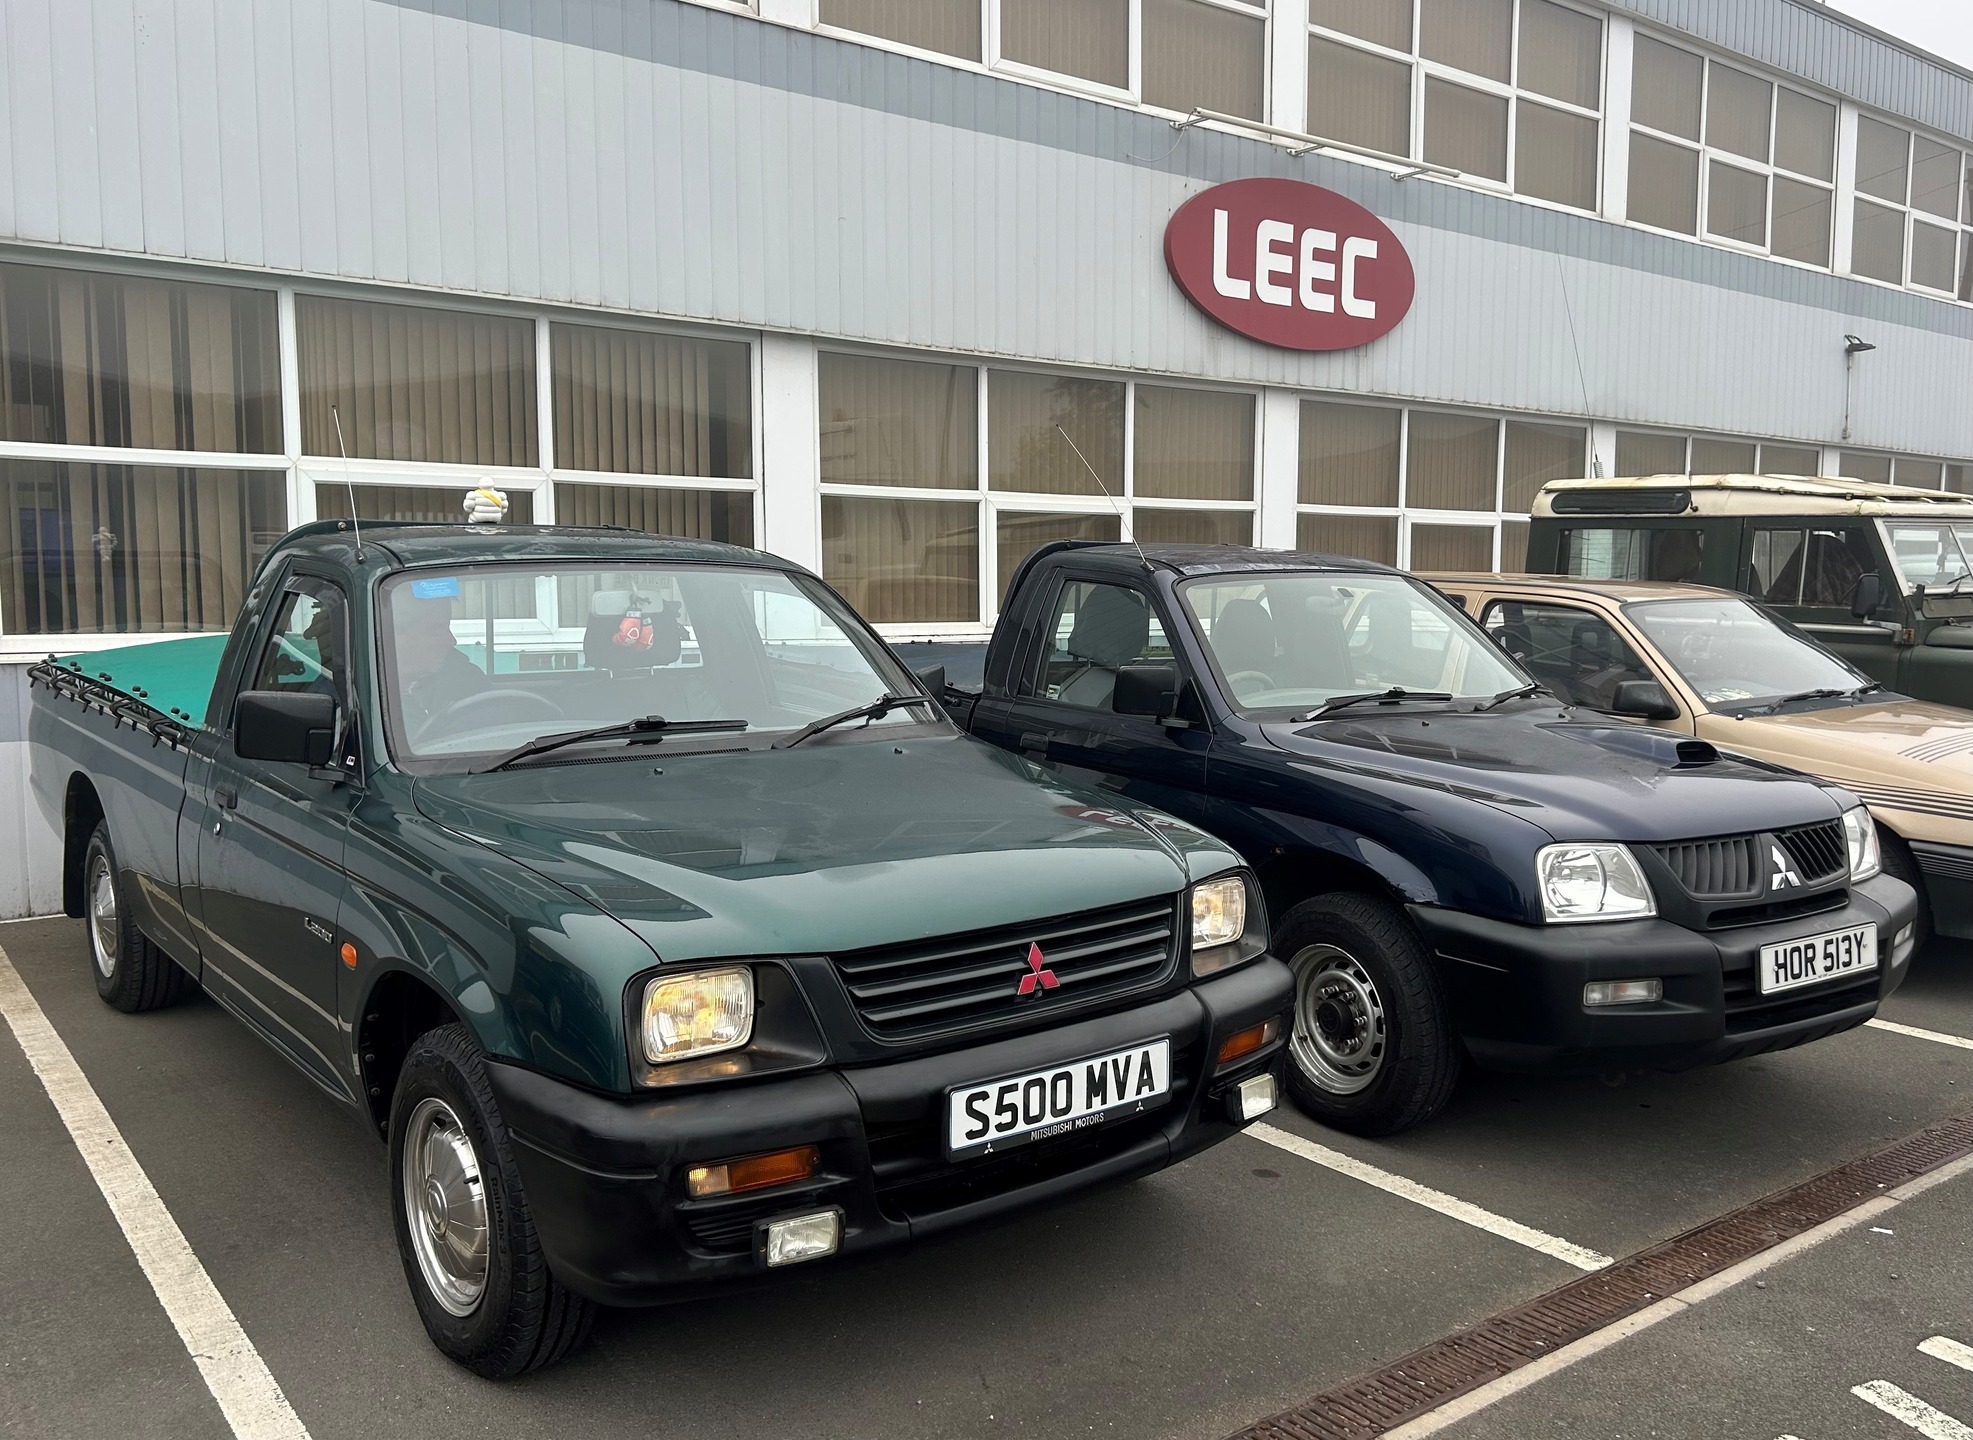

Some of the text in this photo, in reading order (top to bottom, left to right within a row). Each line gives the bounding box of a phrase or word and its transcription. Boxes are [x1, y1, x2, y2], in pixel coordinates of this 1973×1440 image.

[1212, 208, 1378, 320] LEEC
[1774, 931, 1865, 984] HOR 513Y
[965, 1050, 1156, 1141] S500 MVA
[1030, 1112, 1105, 1141] MITSUBISHI MOTORS
[491, 1177, 505, 1241] RainMax
